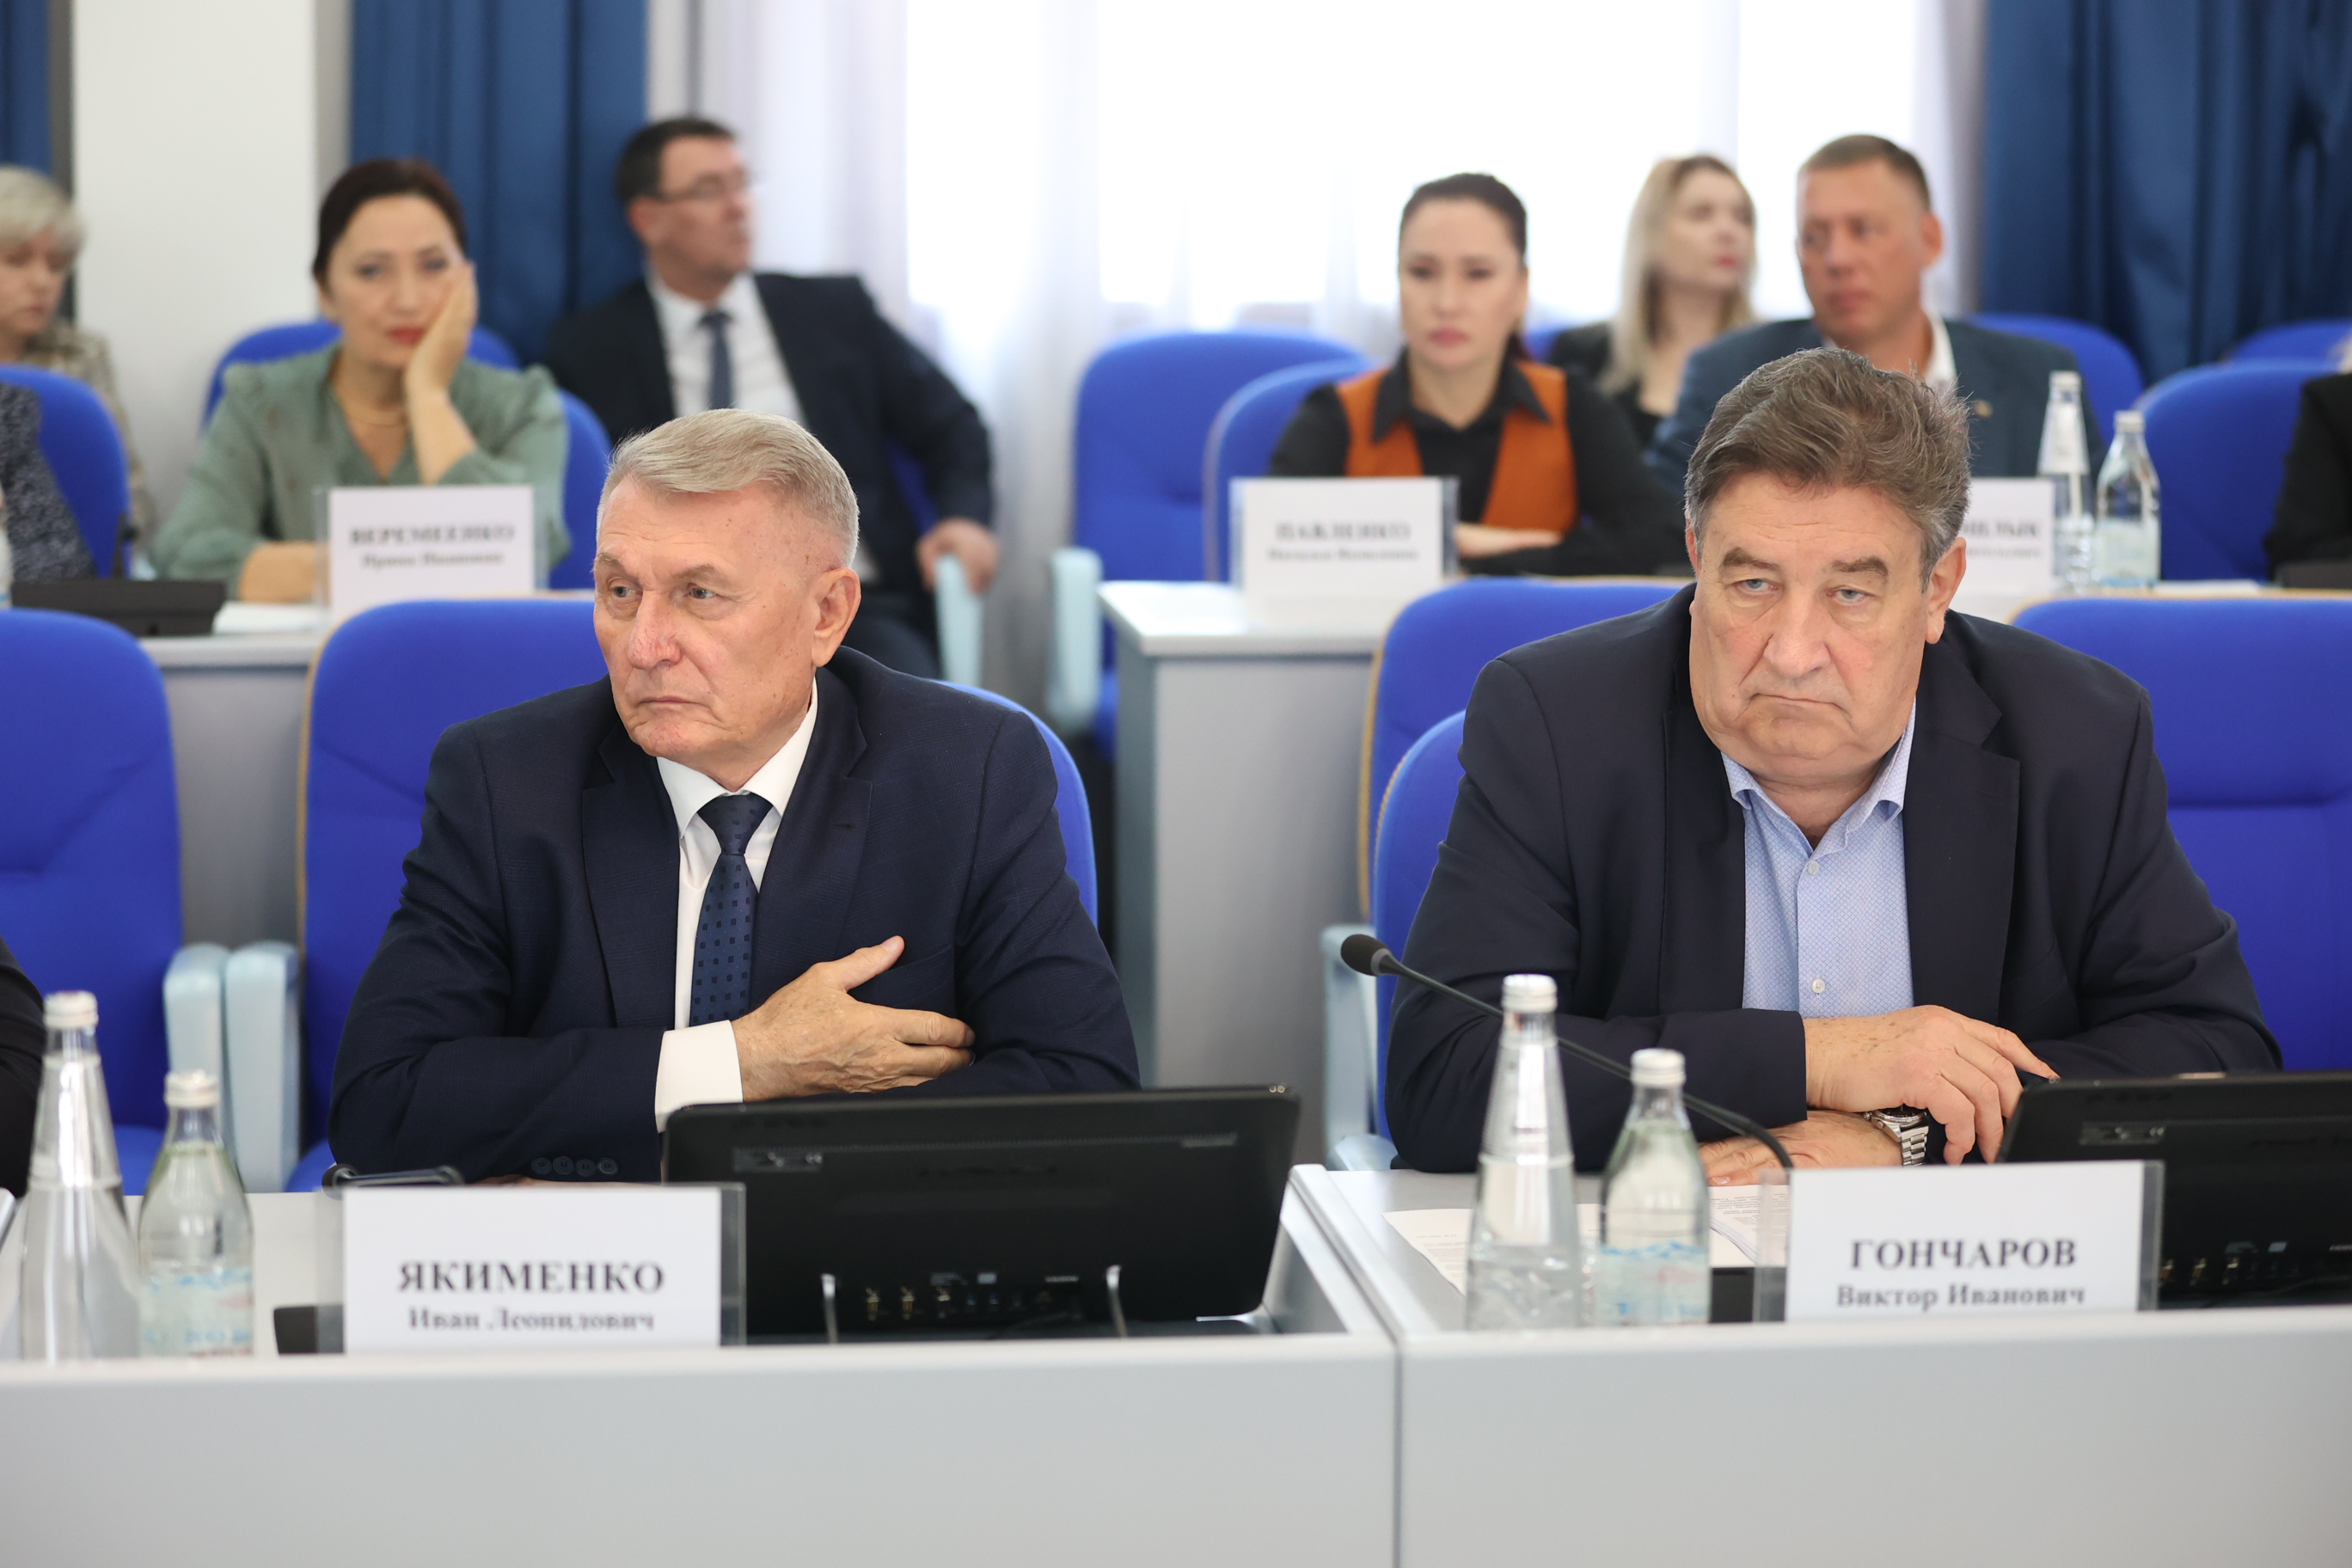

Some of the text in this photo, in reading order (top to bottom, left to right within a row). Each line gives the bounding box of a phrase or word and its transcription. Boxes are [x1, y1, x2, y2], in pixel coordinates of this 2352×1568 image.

[1851, 1239, 2077, 1270] ГОНЧАРОВ
[398, 1262, 665, 1293] ЯКИМЕНКО
[1836, 1283, 2086, 1312] Виктор Иванович
[409, 1308, 654, 1332] Иван Леонидович
